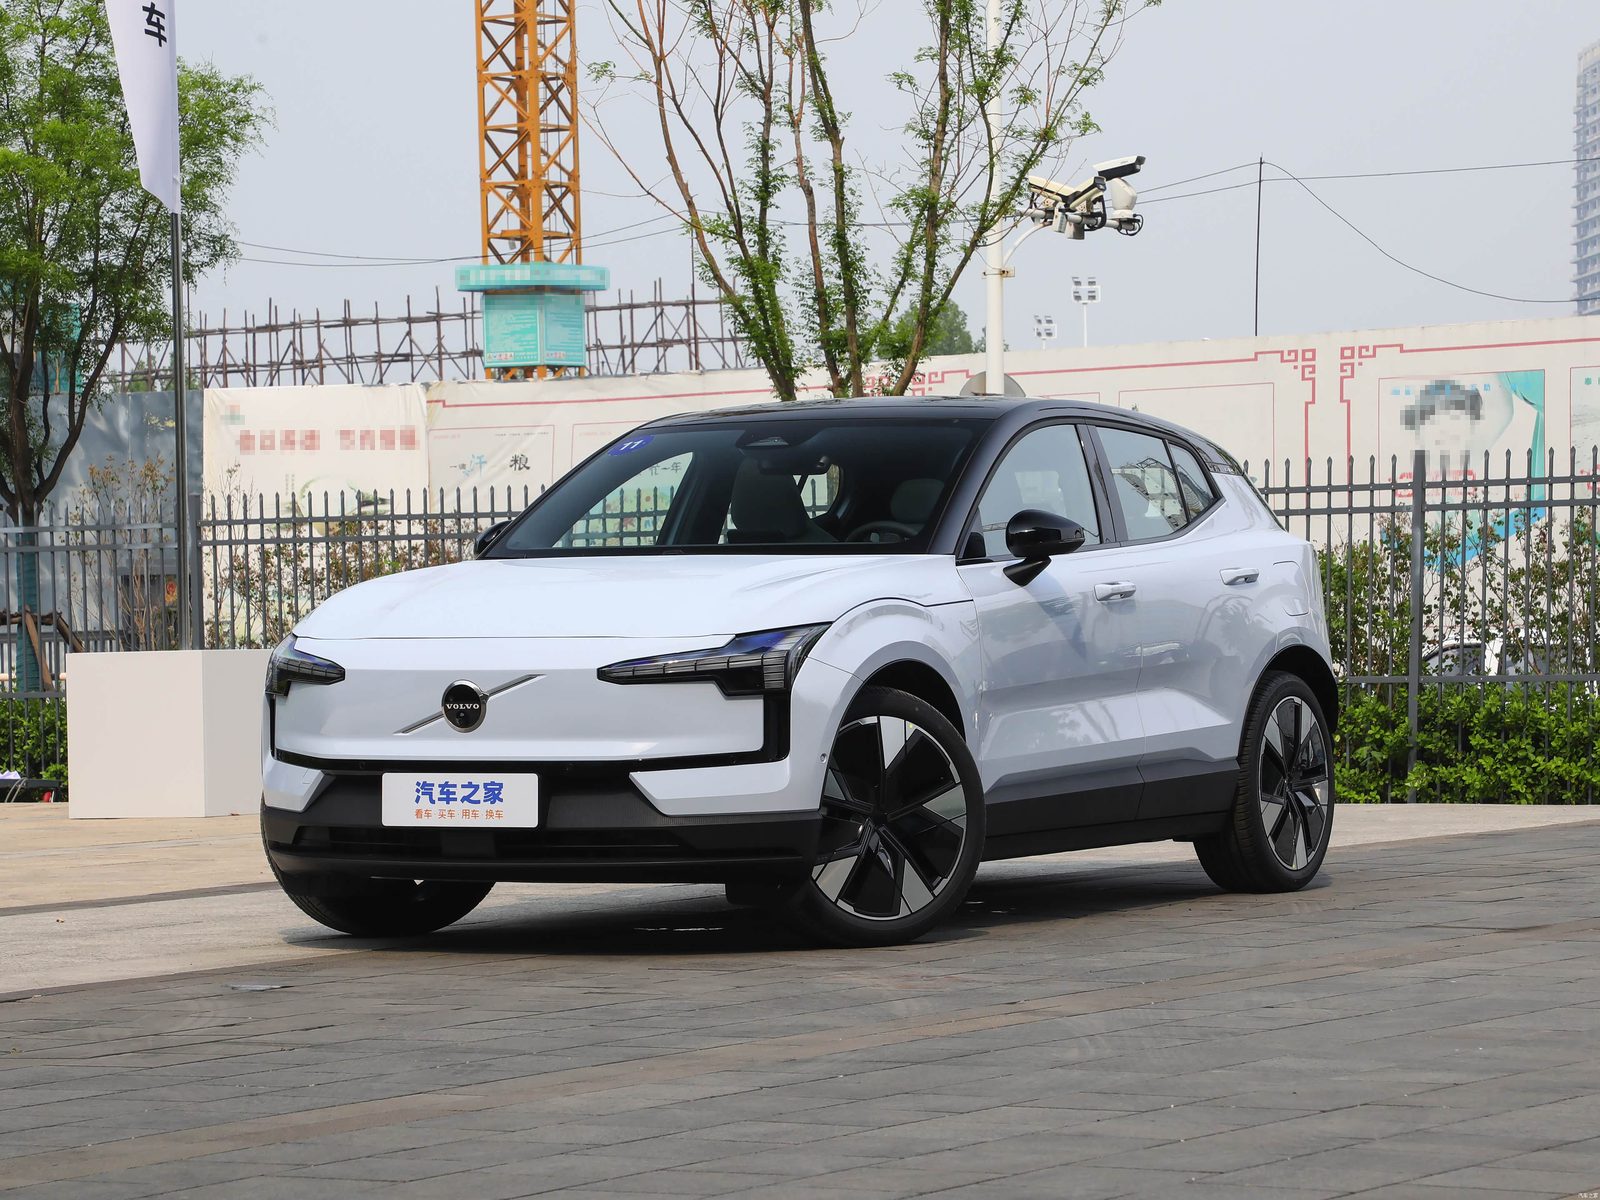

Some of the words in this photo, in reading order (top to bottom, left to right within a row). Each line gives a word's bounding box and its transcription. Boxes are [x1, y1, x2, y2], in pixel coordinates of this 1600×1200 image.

[142, 1, 167, 48] 车
[620, 439, 644, 451] 11
[509, 454, 530, 471] 粮
[414, 780, 504, 805] 汽车之家
